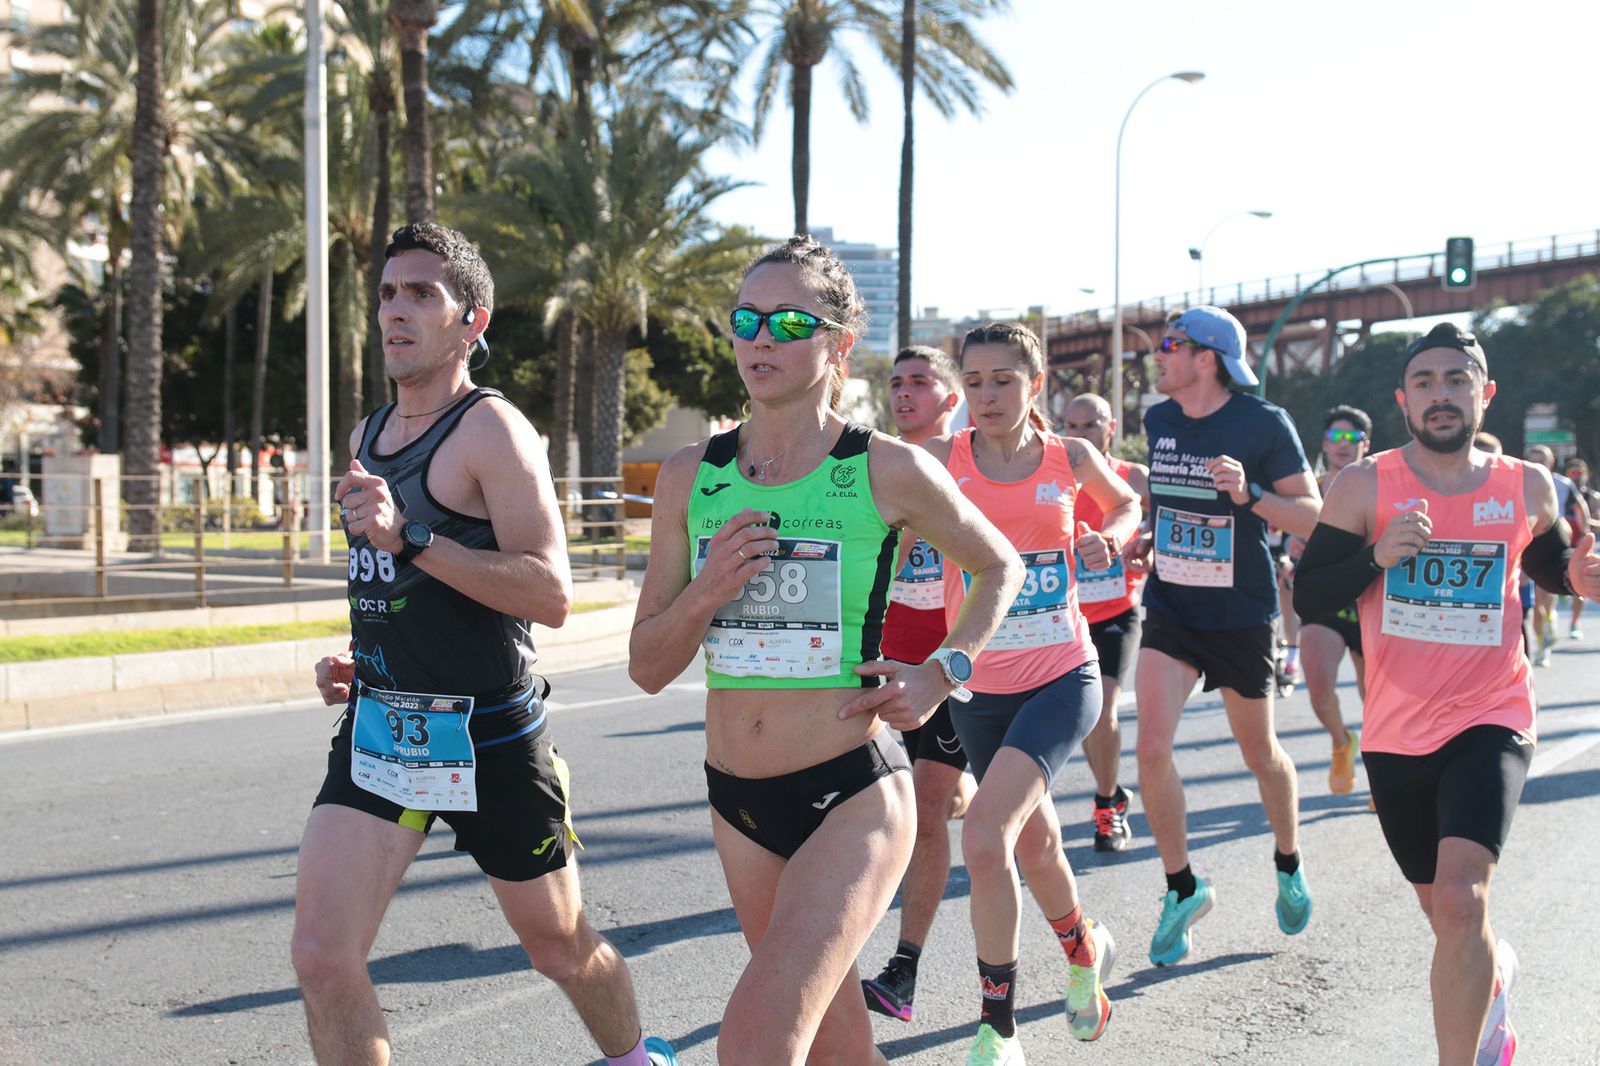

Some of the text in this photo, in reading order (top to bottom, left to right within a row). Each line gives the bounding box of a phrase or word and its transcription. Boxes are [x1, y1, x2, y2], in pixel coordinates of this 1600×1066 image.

[1152, 451, 1214, 464] Medio Marat
[1151, 461, 1189, 475] Almería
[783, 518, 843, 529] correas
[1170, 523, 1215, 548] 819
[349, 547, 395, 582] 898
[1401, 557, 1495, 589] 1037
[732, 561, 808, 604] 58
[1434, 588, 1454, 597] FER
[359, 598, 387, 613] OCR
[1013, 598, 1031, 607] ATA
[743, 604, 780, 615] RUBIO
[394, 695, 420, 703] Maratón
[400, 701, 419, 710] 2022
[385, 708, 431, 747] 93
